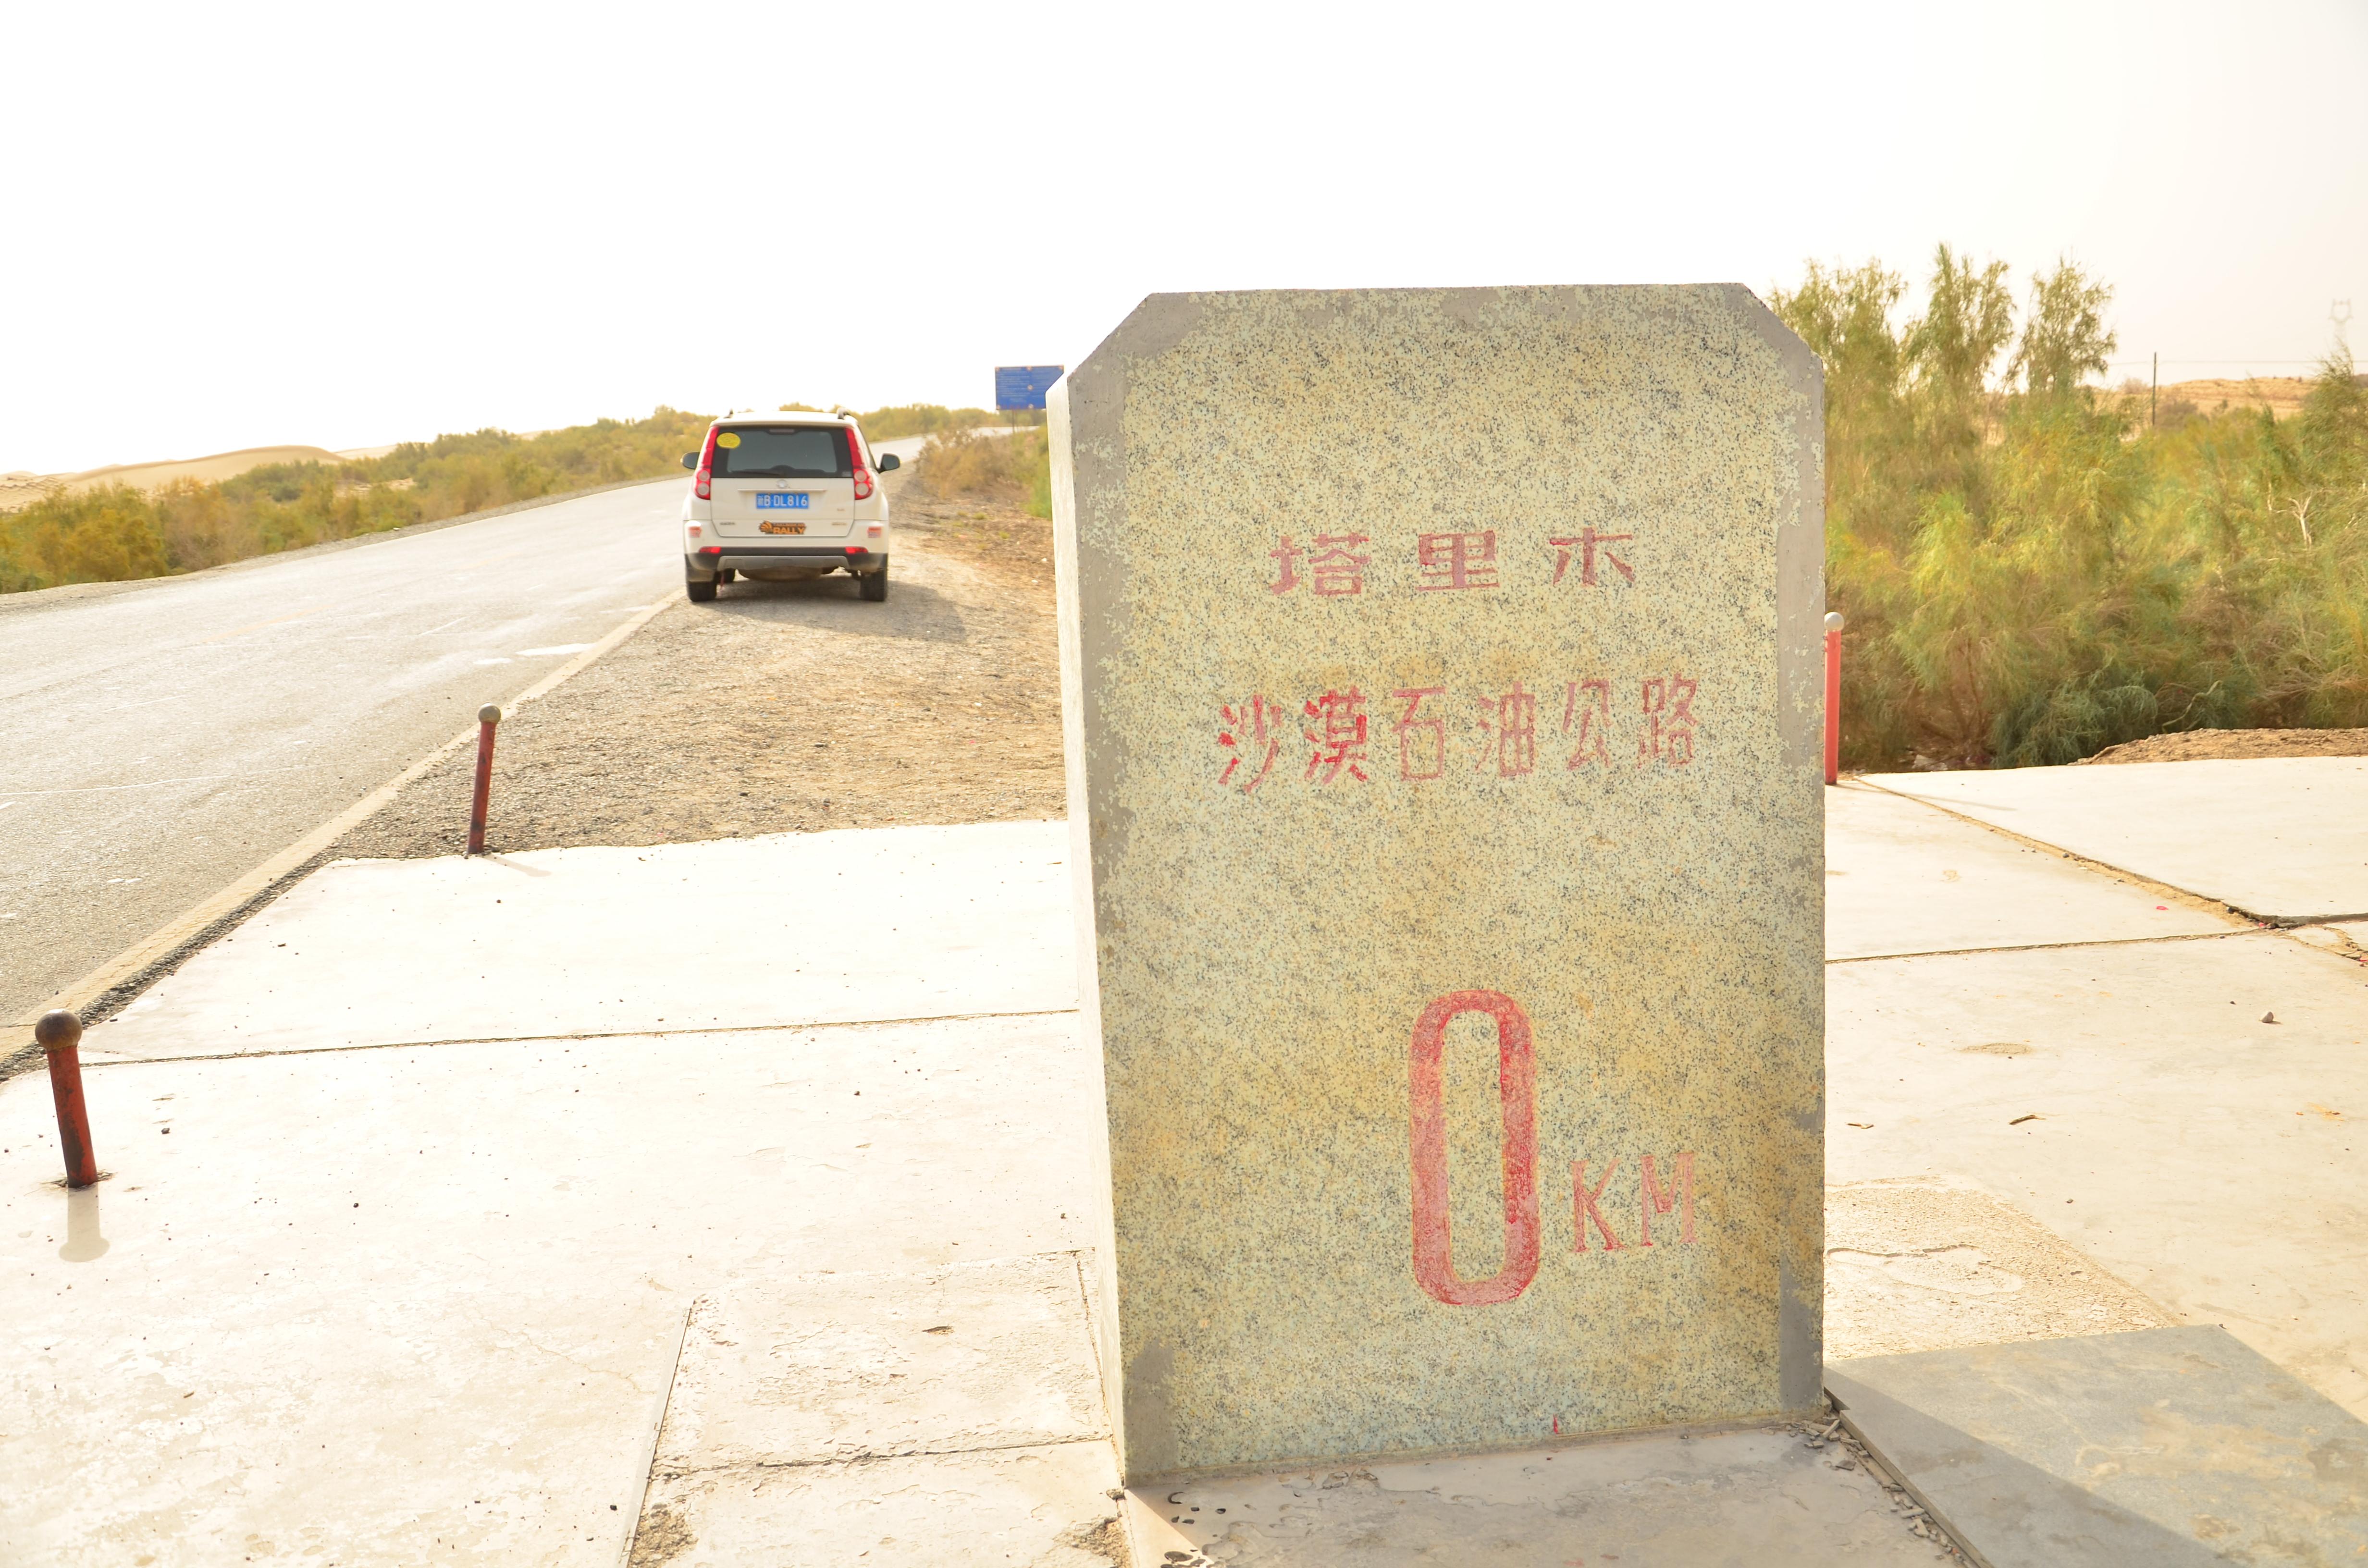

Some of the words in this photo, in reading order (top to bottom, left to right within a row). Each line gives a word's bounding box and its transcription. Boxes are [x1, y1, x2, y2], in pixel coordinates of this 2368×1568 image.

[1270, 527, 1635, 596] 塔里木
[1217, 673, 1699, 793] 沙漠石油公路
[1408, 988, 1540, 1306] 0
[1570, 1152, 1699, 1253] KM
